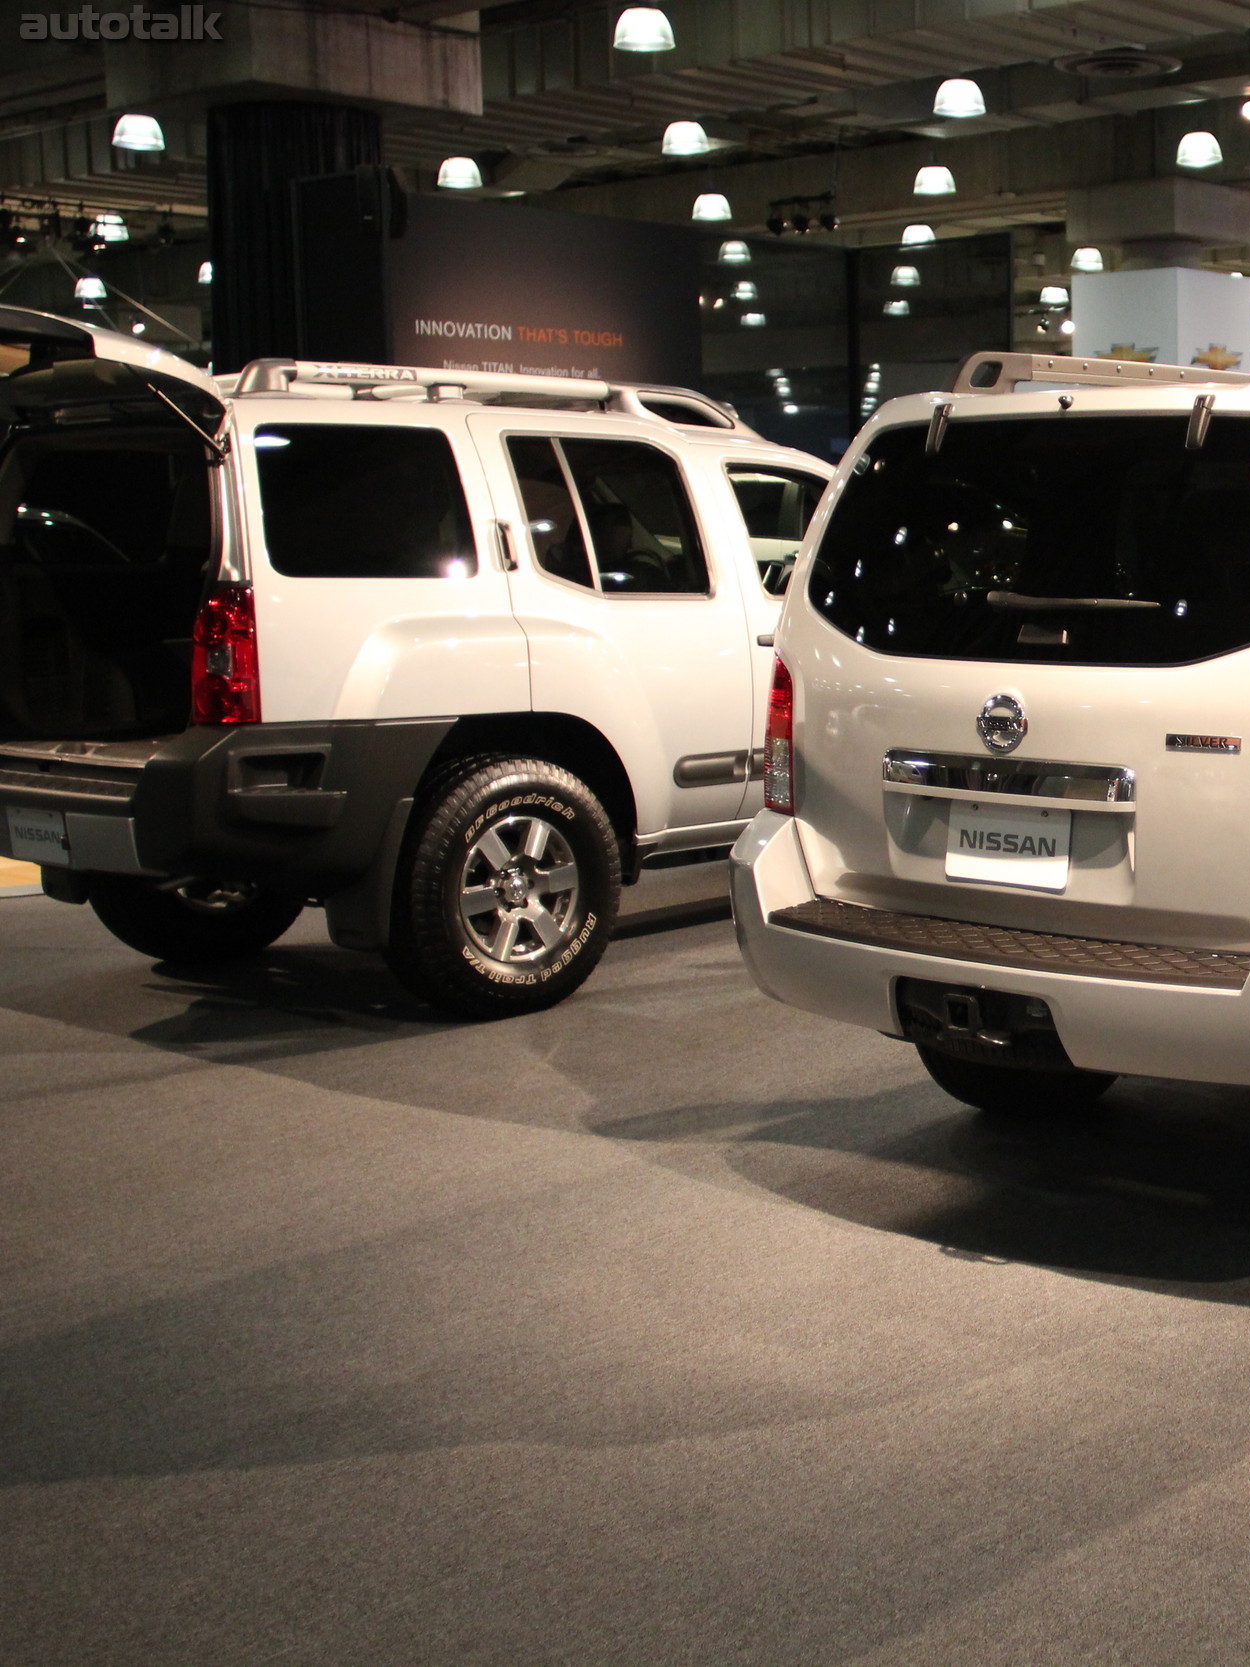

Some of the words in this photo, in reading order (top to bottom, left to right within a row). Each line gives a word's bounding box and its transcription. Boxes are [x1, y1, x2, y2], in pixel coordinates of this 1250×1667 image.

[415, 318, 513, 342] INNOVATION
[516, 326, 568, 344] THAT'S
[574, 330, 623, 347] TOUGH
[519, 363, 569, 378] Innovation
[571, 366, 585, 379] for
[1176, 735, 1228, 750] SILVER
[15, 826, 61, 844] NISSAN
[959, 828, 1057, 858] NISSAN
[541, 911, 598, 982] Rugged
[462, 945, 487, 976] T/A
[488, 970, 537, 985] Trail
